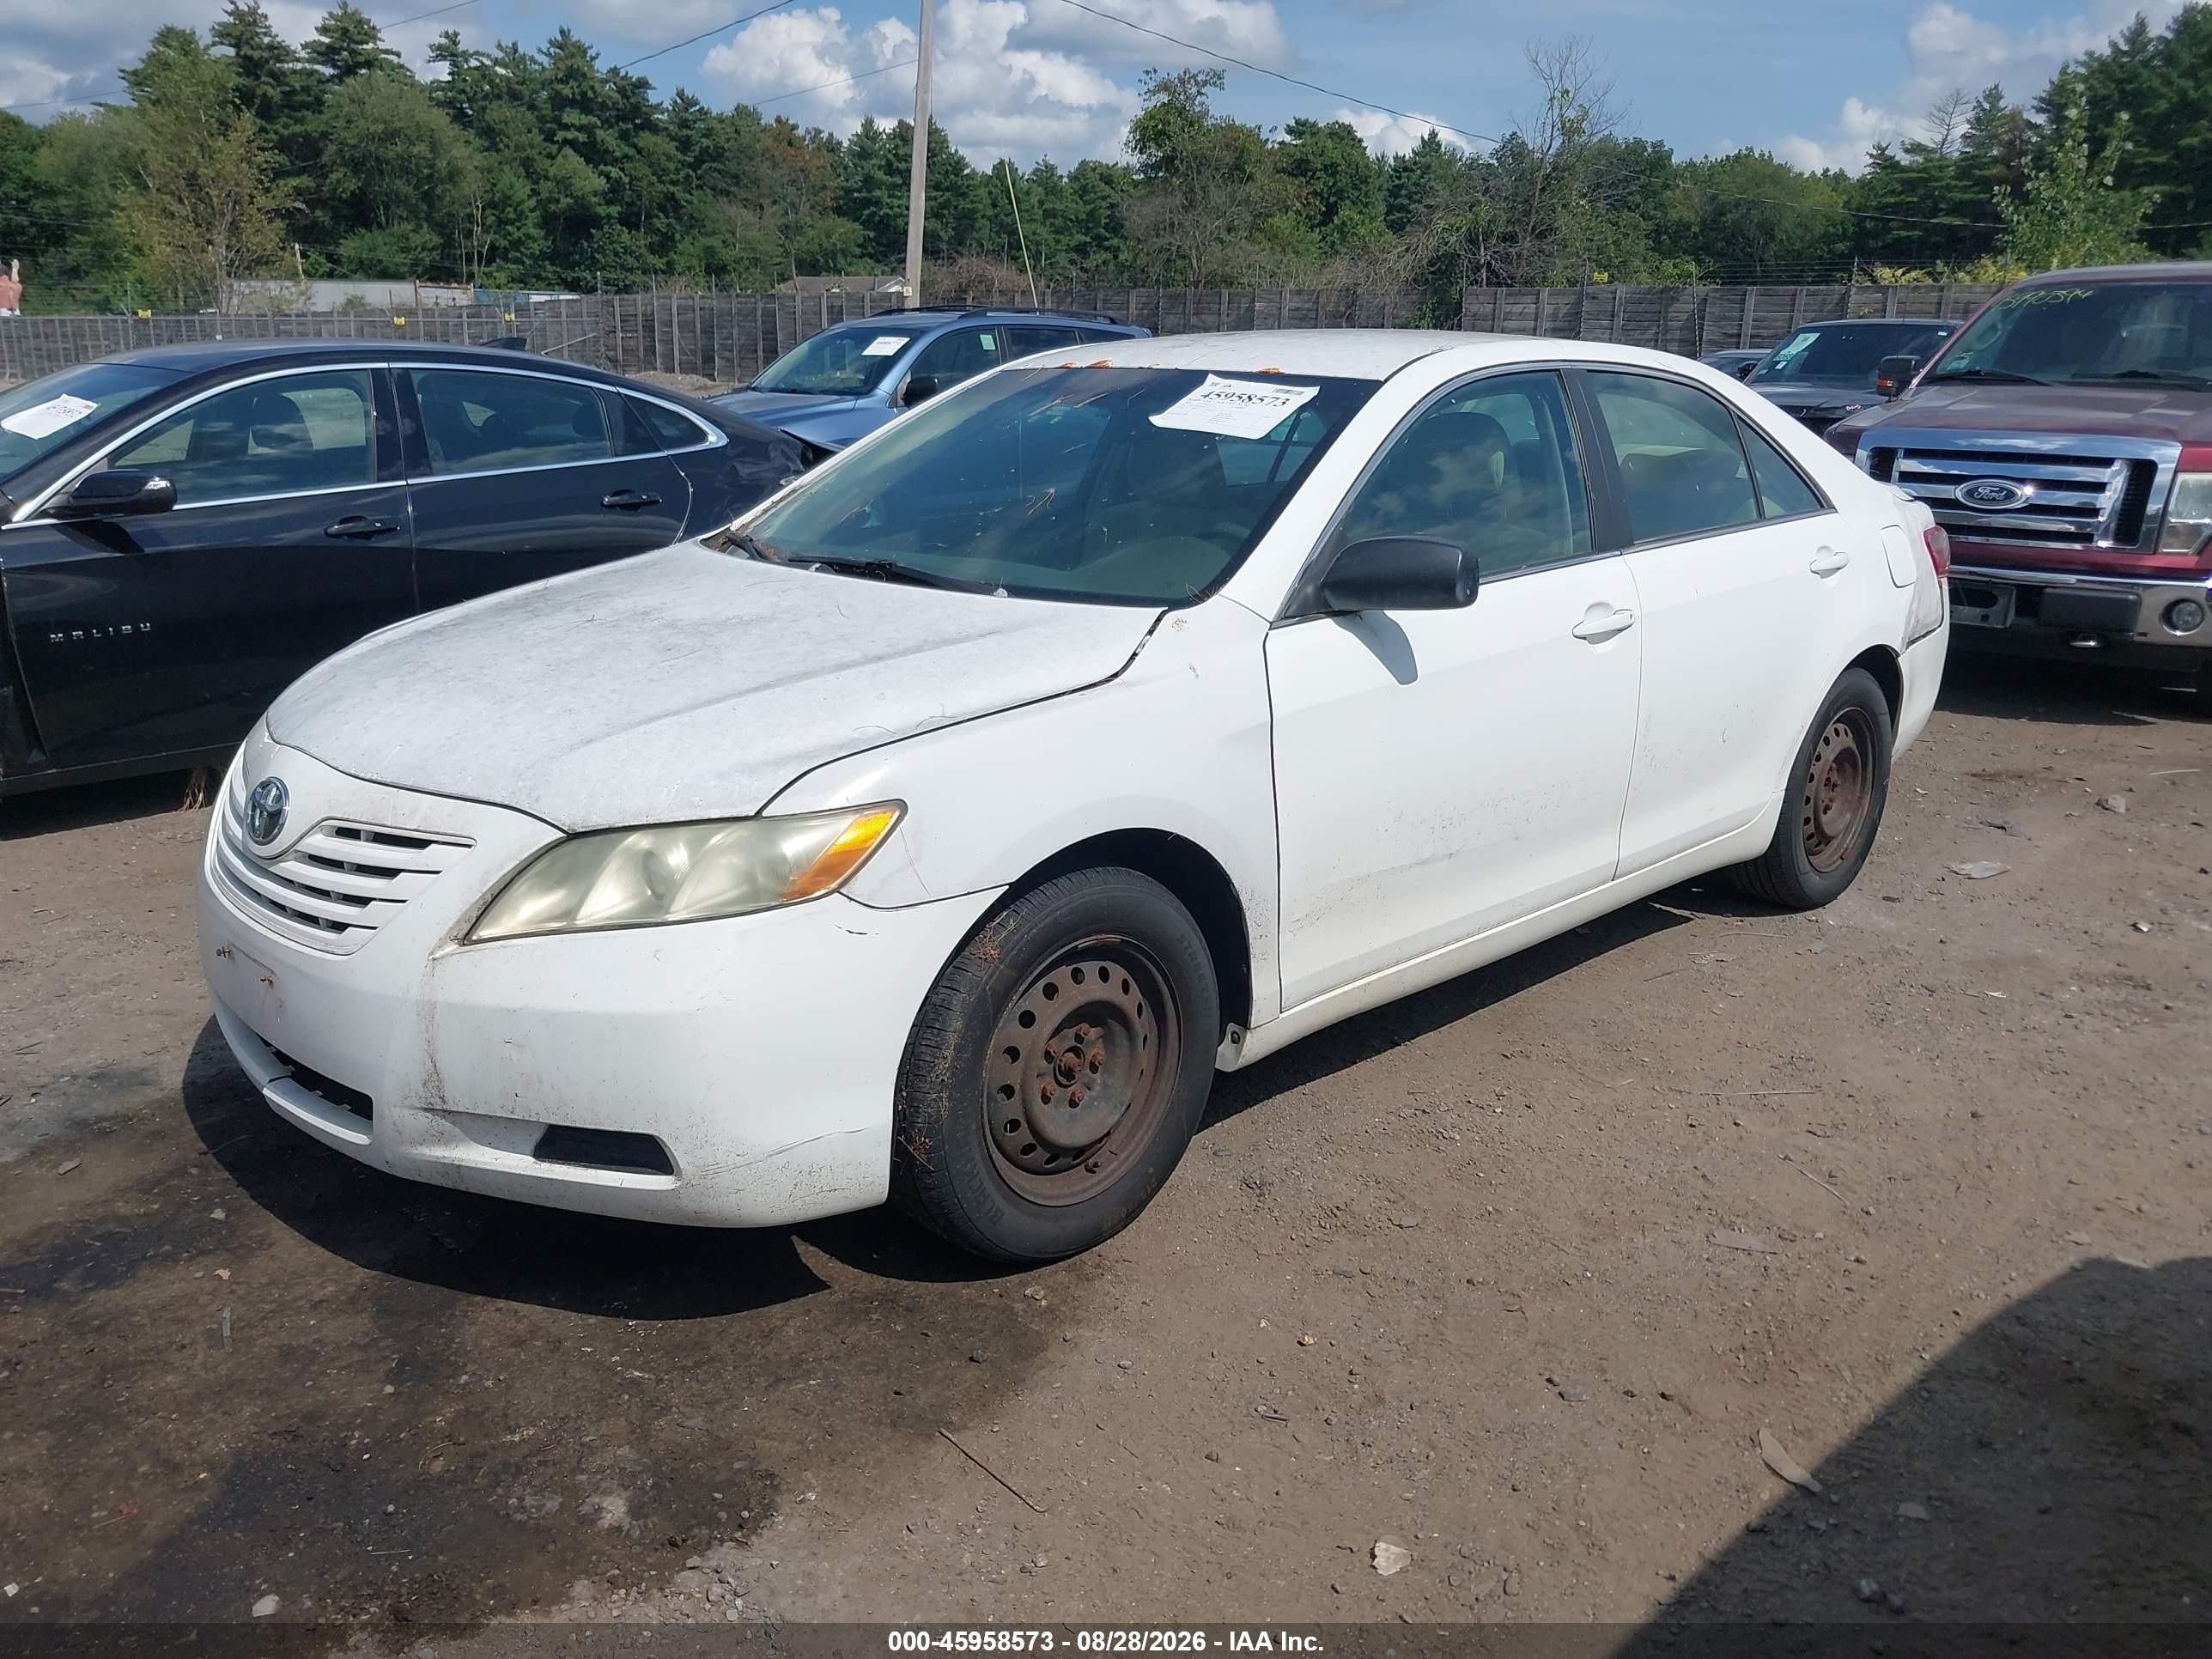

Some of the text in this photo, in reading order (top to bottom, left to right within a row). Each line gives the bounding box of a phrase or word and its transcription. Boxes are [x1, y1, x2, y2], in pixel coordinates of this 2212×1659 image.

[1200, 390, 1291, 407] 45958573
[1973, 486, 2008, 500] Ford
[50, 622, 151, 642] MALIBU
